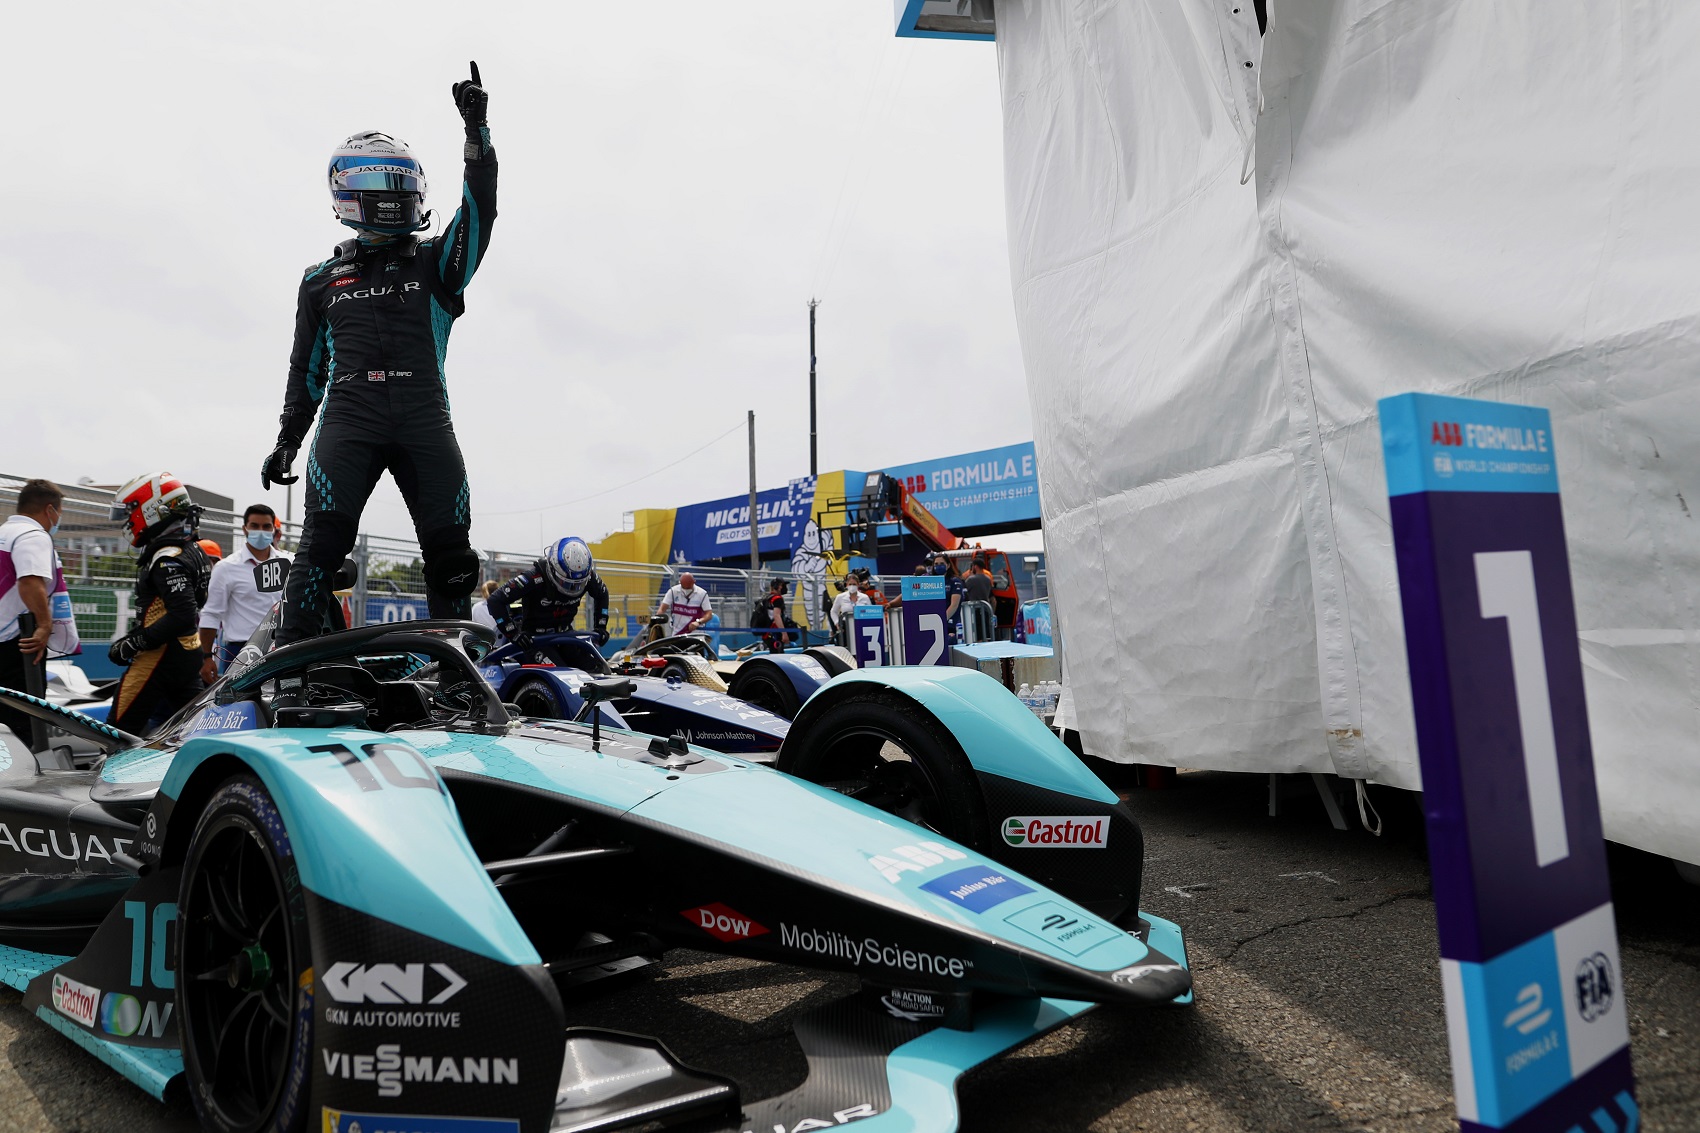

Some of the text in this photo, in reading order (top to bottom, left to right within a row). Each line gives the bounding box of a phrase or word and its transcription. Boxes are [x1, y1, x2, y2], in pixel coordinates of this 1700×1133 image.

[355, 166, 413, 175] JAGUAR
[327, 281, 421, 308] JAGUAR
[1431, 421, 1549, 453] ABB FORMULA E
[931, 458, 1018, 492] FORMULA
[1022, 455, 1033, 477] E
[919, 486, 1034, 513] ORLD CHAMPIONSHIP
[720, 530, 741, 540] PILOT
[741, 526, 765, 538] SPRT
[262, 562, 281, 588] BIR
[862, 627, 882, 667] 3
[918, 614, 944, 665] 2
[1473, 550, 1569, 868] 1
[191, 713, 223, 735] Julius
[223, 711, 249, 730] Bär
[695, 731, 726, 740] Johnson
[726, 732, 756, 742] Matthey
[305, 743, 447, 797] 10
[1027, 818, 1103, 846] Castrol
[867, 841, 968, 885] ABB
[950, 874, 1007, 900] Julius Bär
[62, 981, 96, 1021] Castrol
[903, 991, 932, 1004] ACTION
[1574, 964, 1612, 1013] FIA
[325, 1007, 461, 1028] GKN AUTOMOTIVE
[901, 1000, 919, 1011] ROAD
[920, 1004, 945, 1014] SAFETY
[322, 1044, 519, 1097] VIESSMANN
